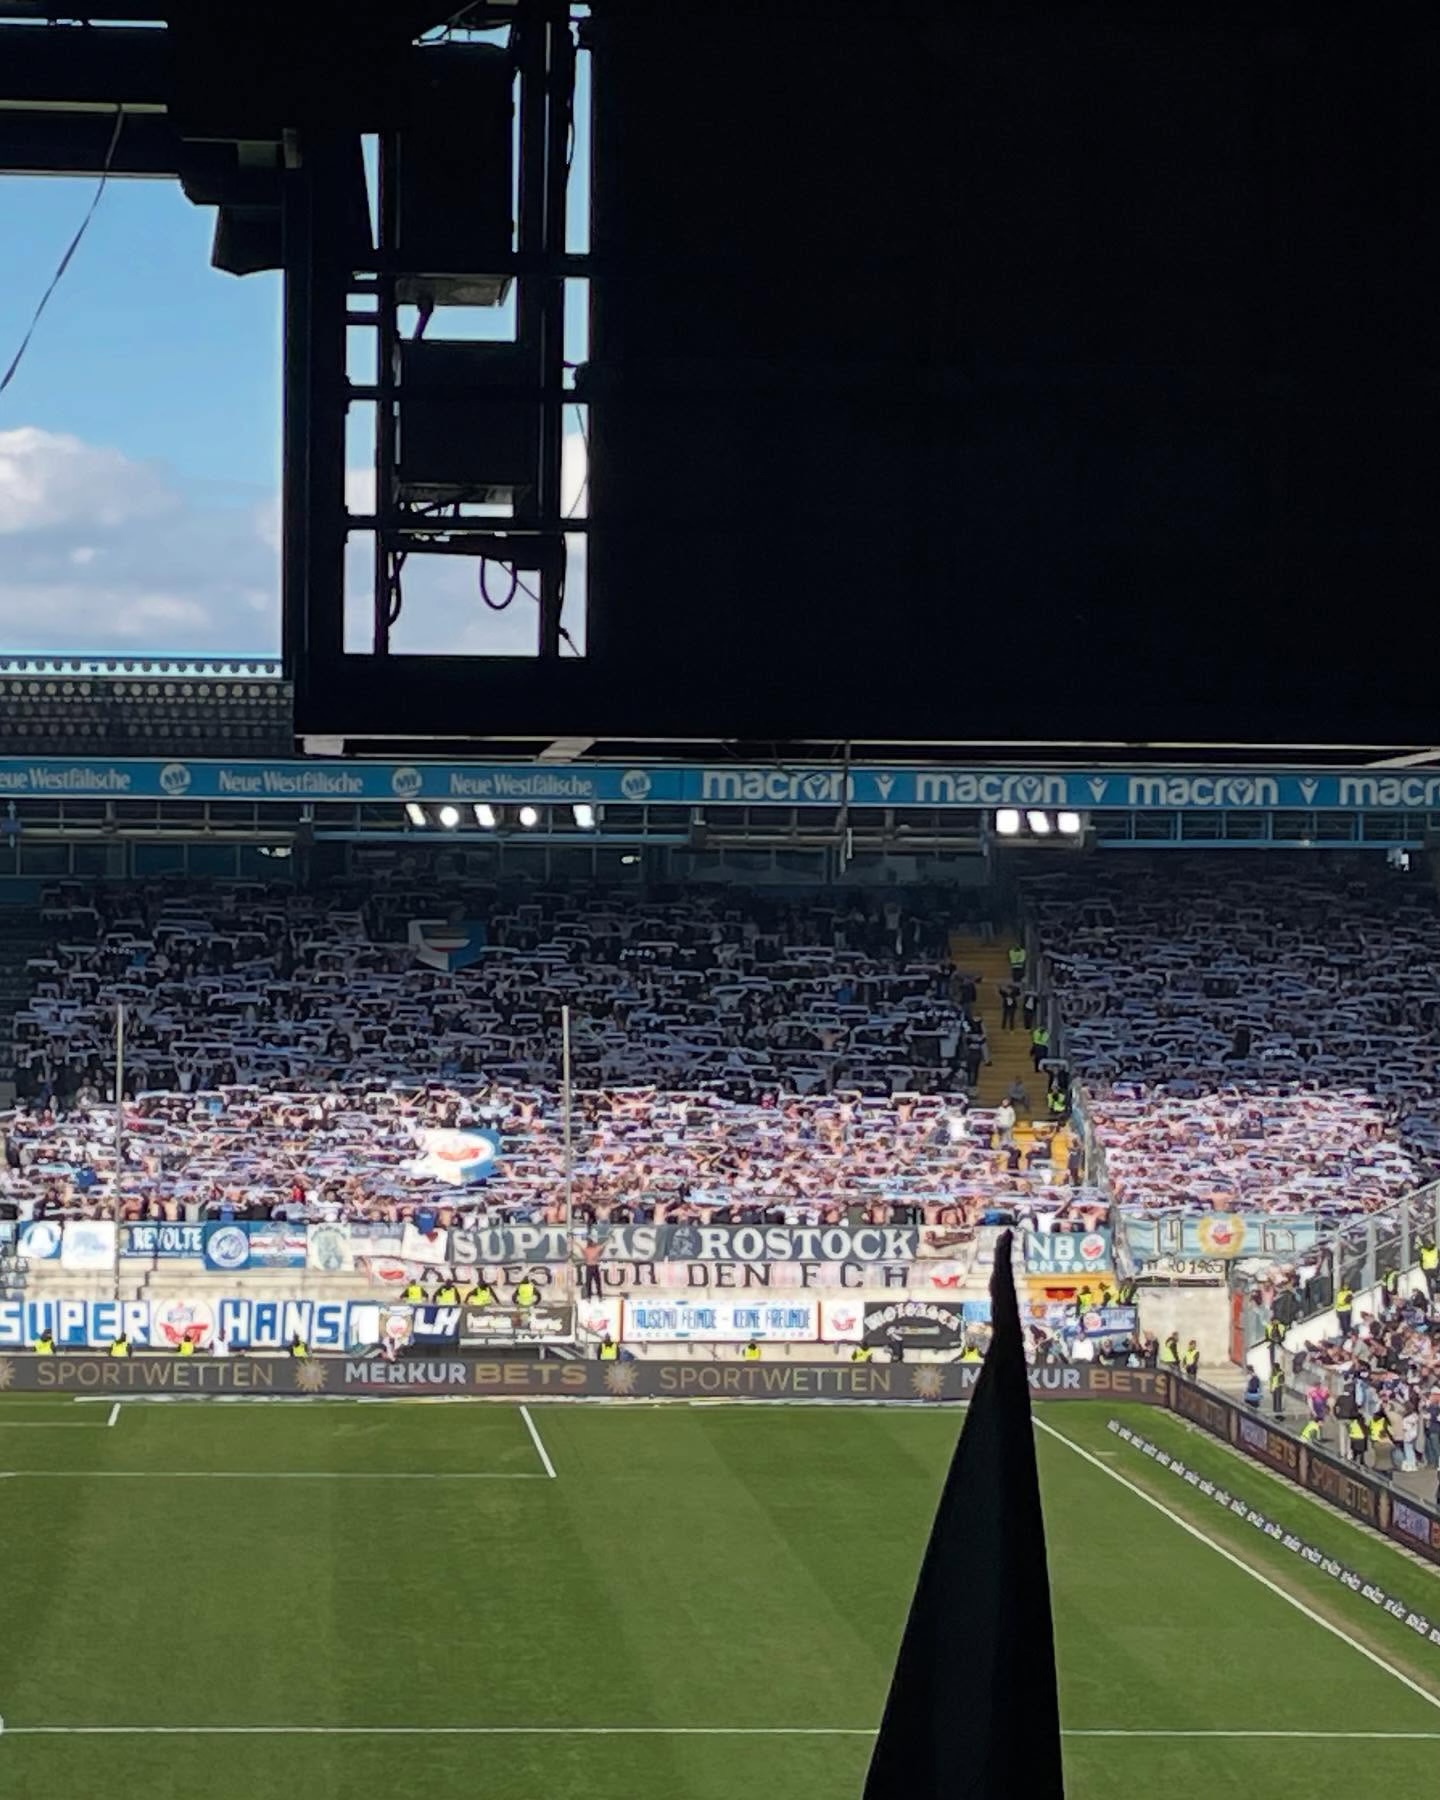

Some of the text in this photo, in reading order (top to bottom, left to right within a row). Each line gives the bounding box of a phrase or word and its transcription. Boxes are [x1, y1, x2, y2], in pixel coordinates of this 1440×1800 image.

[218, 769, 364, 794] Neue Westfälische
[450, 771, 493, 794] Neue
[702, 770, 855, 801] macron
[916, 773, 1069, 803] macron
[1128, 776, 1279, 806] macron
[133, 1227, 203, 1251] REVOLTE
[698, 1226, 914, 1260] ROSTOCK
[1027, 1233, 1075, 1260] NB
[687, 1262, 772, 1288] DEN
[0, 1302, 149, 1345] SUPER
[37, 1362, 273, 1387] SPORTWETTEN
[345, 1362, 587, 1386] MERKUR BETS
[660, 1366, 891, 1393] SPORTWETTEN
[1089, 1369, 1167, 1396] BETS
